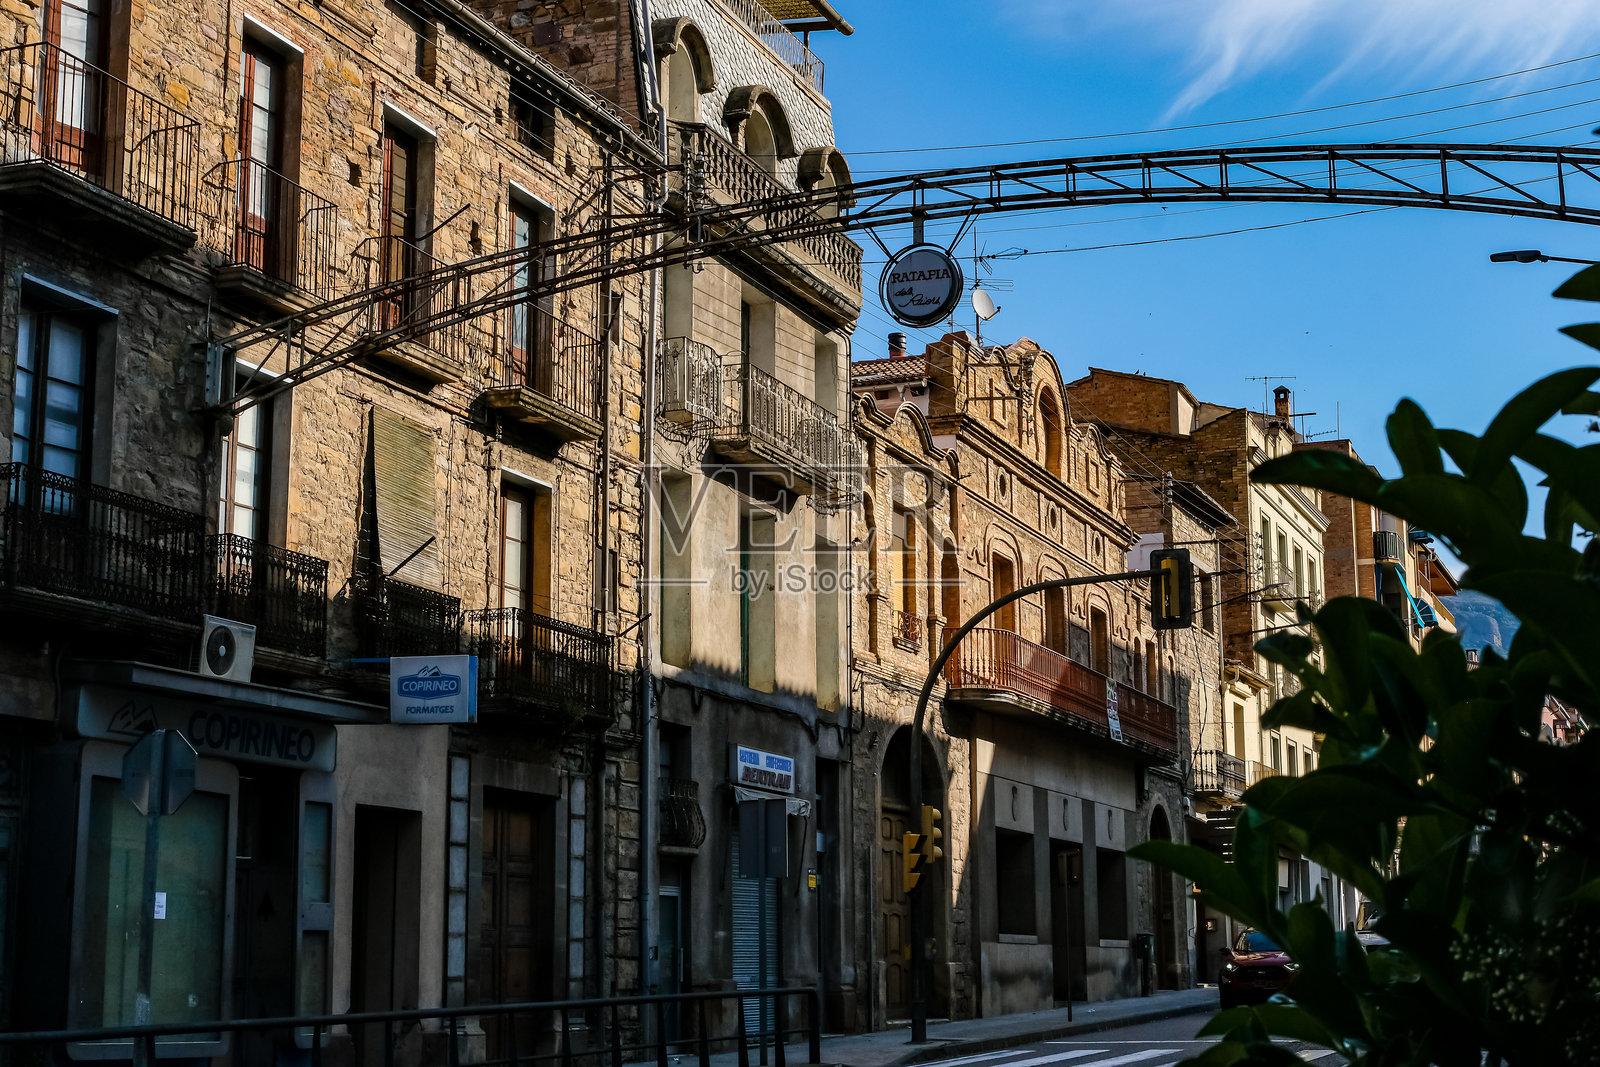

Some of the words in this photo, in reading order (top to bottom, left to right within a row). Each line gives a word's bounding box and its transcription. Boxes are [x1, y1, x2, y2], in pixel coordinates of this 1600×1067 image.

[891, 268, 951, 283] RATAFIA
[402, 680, 457, 692] COPIRINEO
[406, 705, 455, 715] FORMATGES
[187, 709, 315, 762] COPIRINEO
[742, 766, 791, 789] BERTRAN
